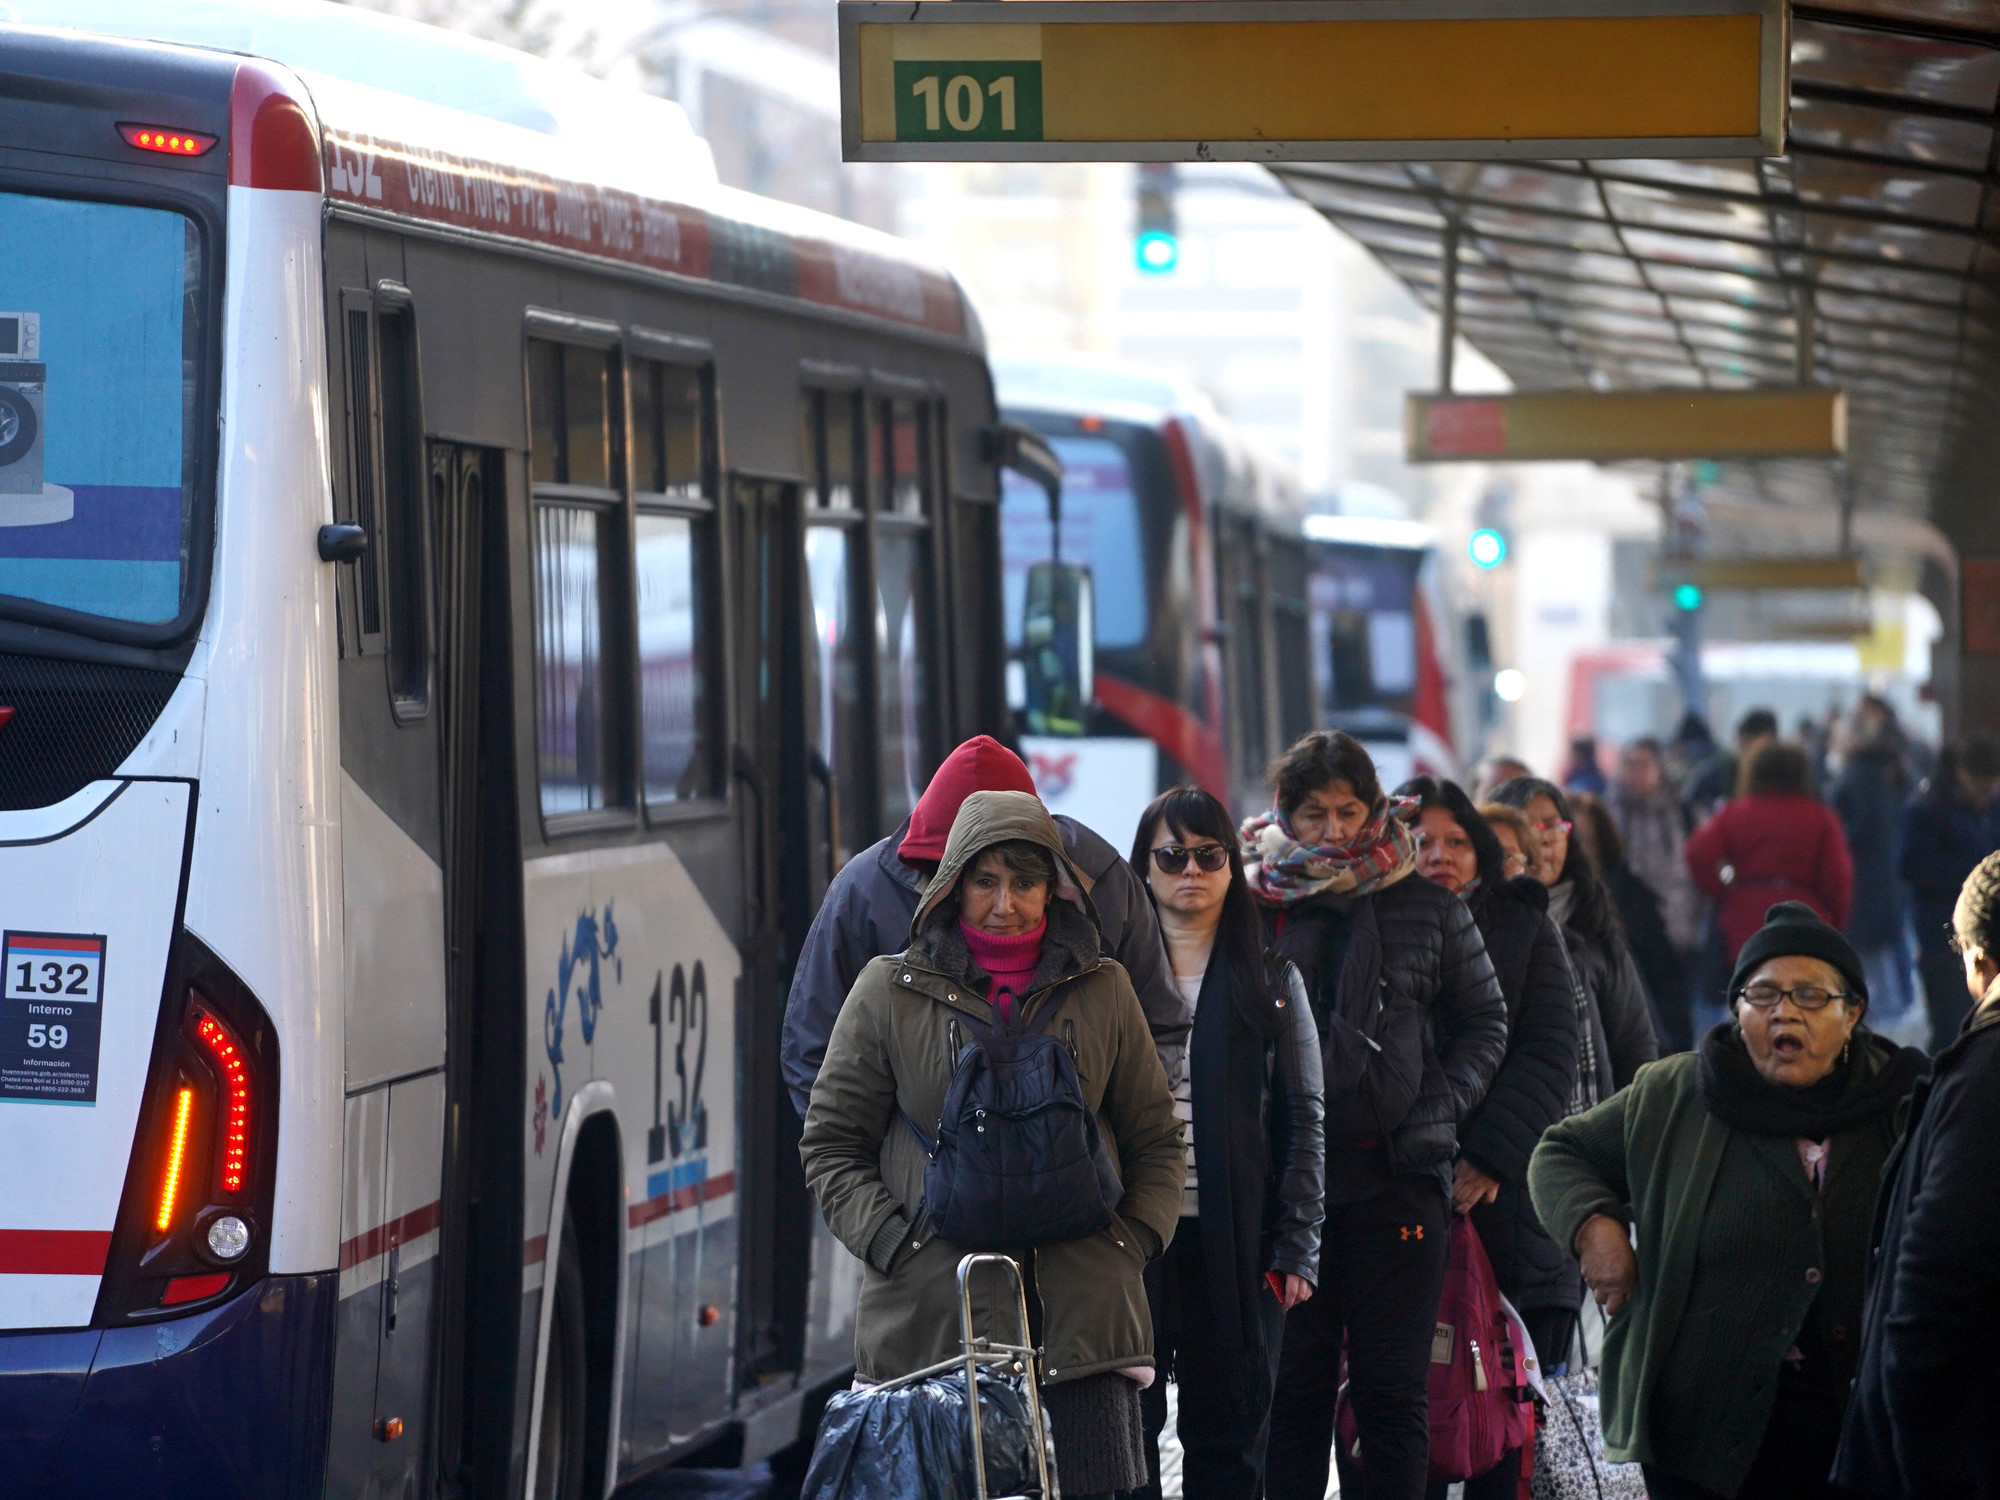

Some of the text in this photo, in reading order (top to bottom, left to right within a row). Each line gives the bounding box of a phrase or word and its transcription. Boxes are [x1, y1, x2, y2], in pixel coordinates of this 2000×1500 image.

[912, 74, 1016, 132] 101
[331, 130, 383, 200] 132
[15, 961, 89, 995] 132
[28, 1003, 73, 1016] Interno
[27, 1023, 68, 1049] 59
[23, 1058, 70, 1068] Información
[648, 959, 708, 1166] 132
[5, 1083, 34, 1091] Reclamos
